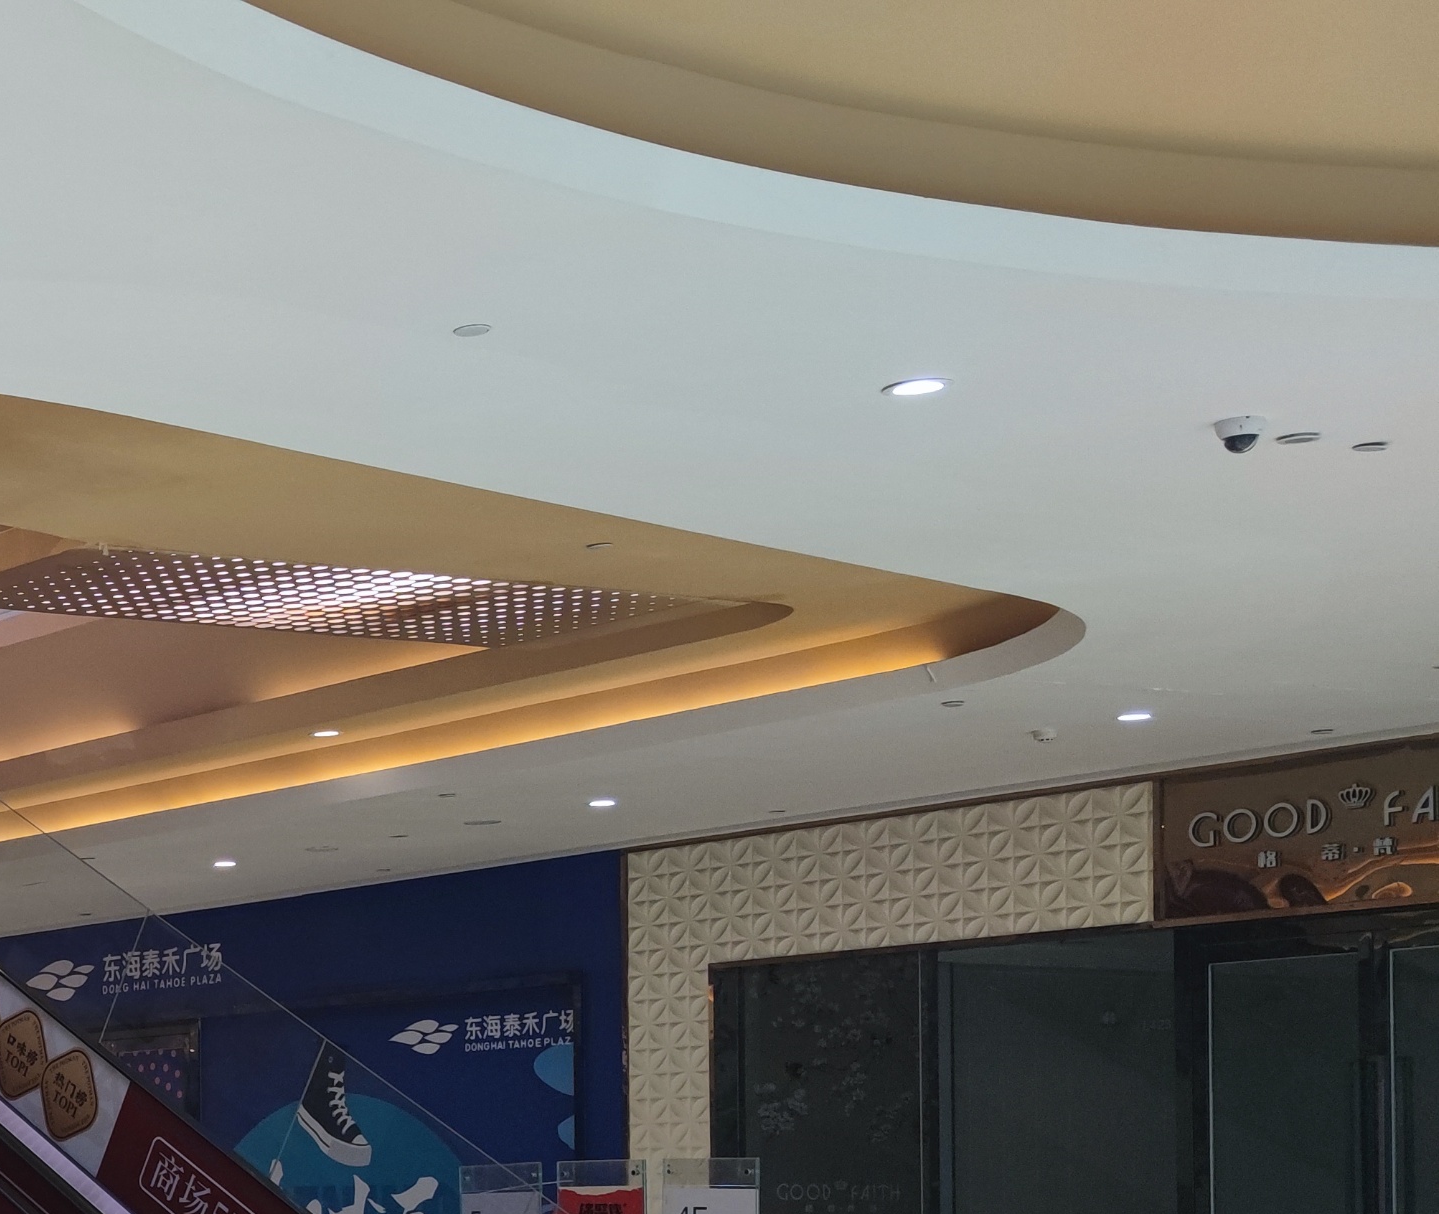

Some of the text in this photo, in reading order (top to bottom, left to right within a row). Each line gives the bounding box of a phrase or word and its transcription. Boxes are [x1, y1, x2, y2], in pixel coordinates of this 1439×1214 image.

[1187, 798, 1332, 849] GOOD
[101, 943, 223, 983] 东海泰禾广场
[133, 980, 151, 991] HAI
[154, 977, 187, 990] TAHOE
[190, 973, 222, 986] PLAZA
[463, 1008, 575, 1042] 东海泰禾广场
[7, 1033, 39, 1067] 口味榜
[463, 1036, 572, 1053] DONGHAI TAHOE PLAZ
[4, 1050, 28, 1078] TOP1
[53, 1071, 88, 1107] 热门榜
[52, 1092, 78, 1119] TOP1
[776, 1182, 832, 1202] GOOD
